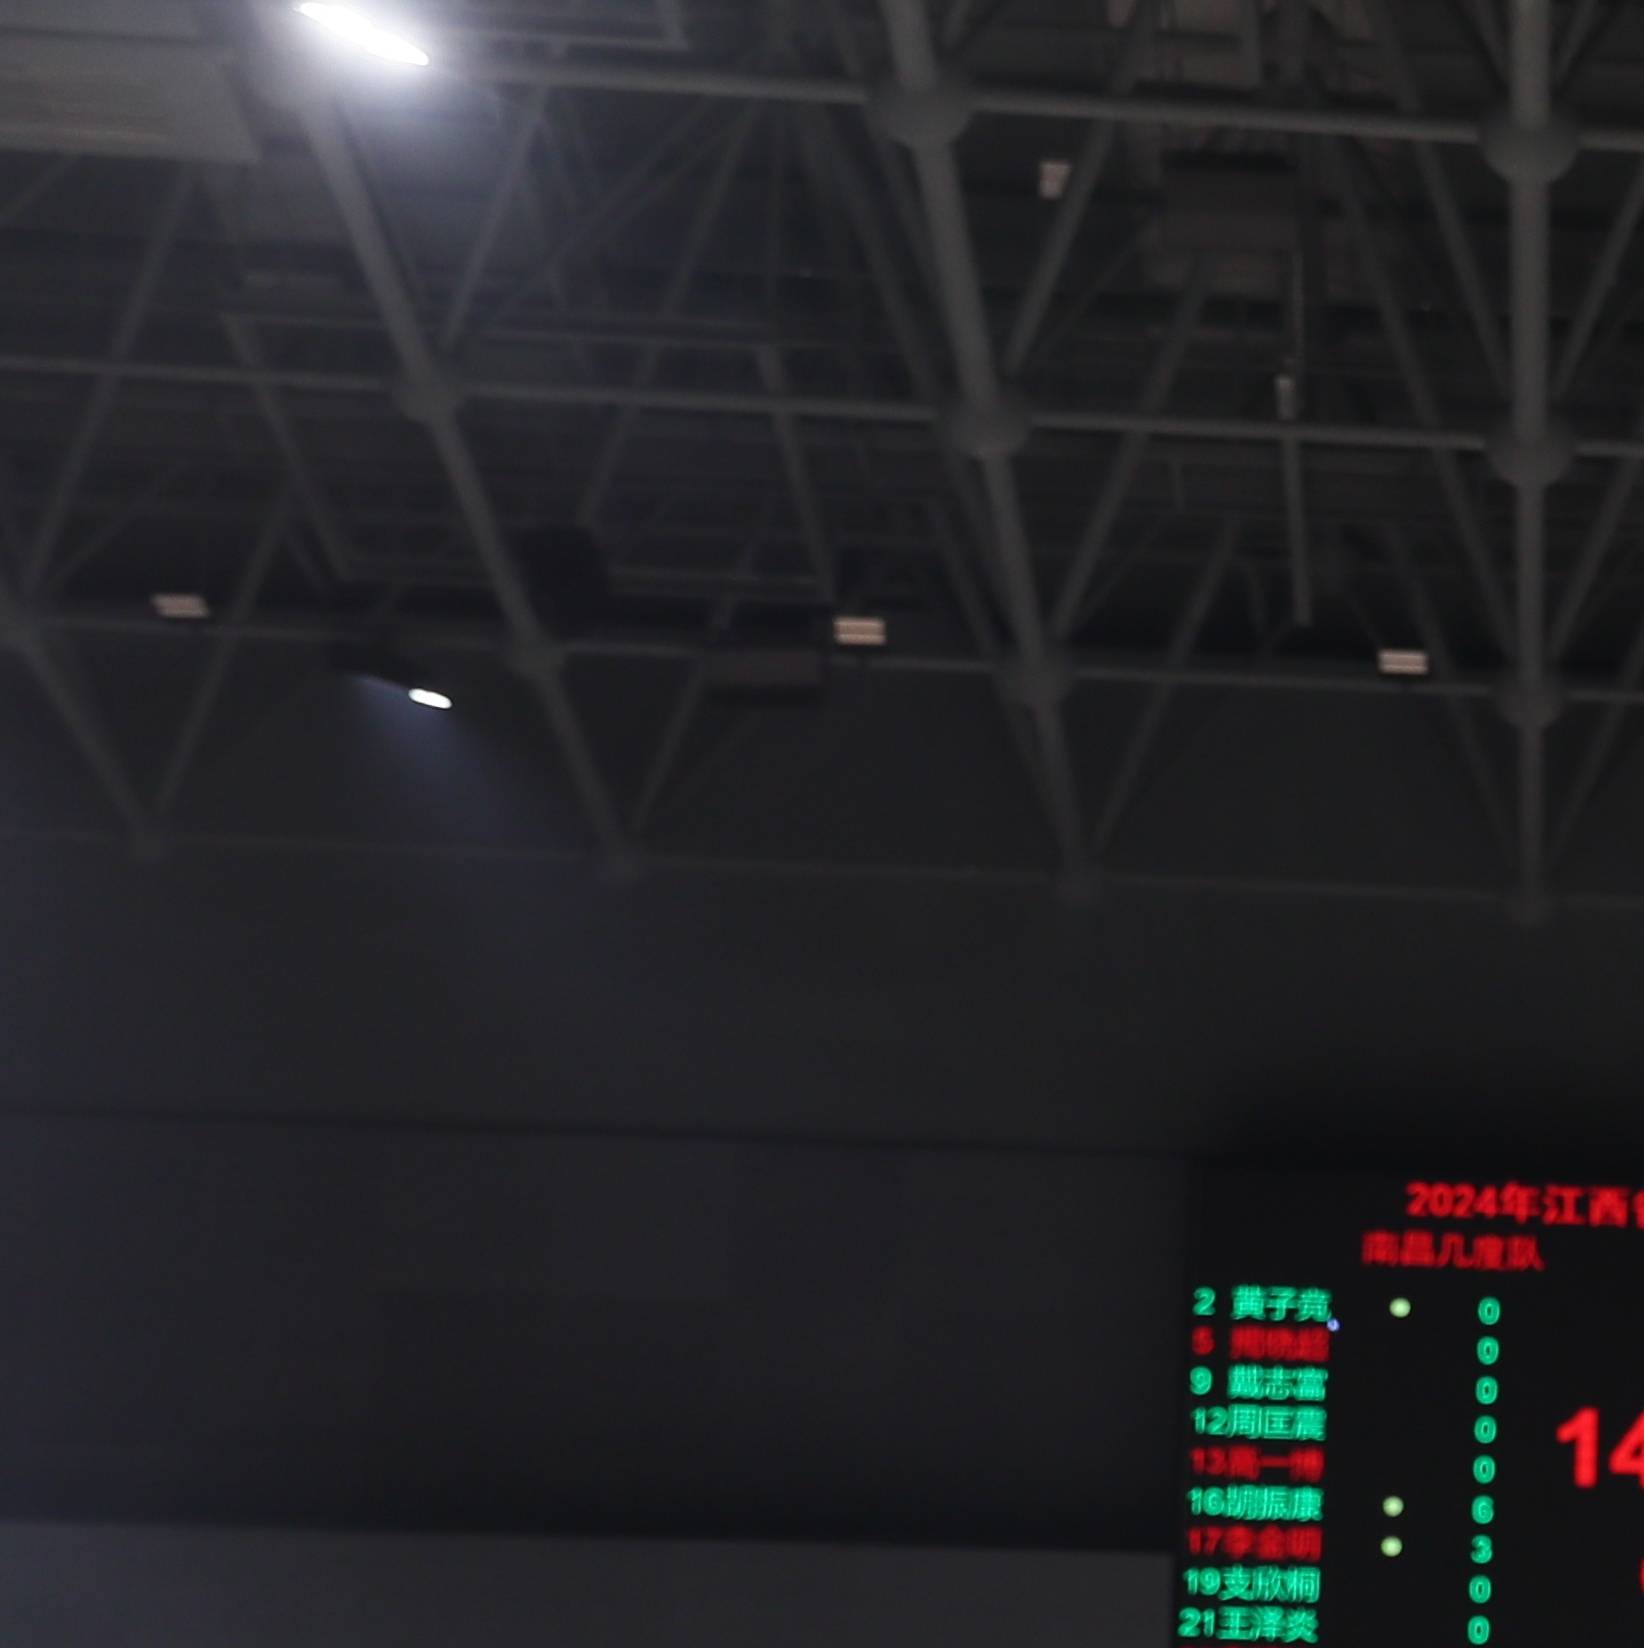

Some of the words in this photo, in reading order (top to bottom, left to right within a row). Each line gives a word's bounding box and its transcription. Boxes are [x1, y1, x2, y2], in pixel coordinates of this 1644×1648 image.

[1194, 1288, 1215, 1315] 2
[1478, 1297, 1500, 1325] 0
[1477, 1336, 1499, 1365] 0
[1190, 1367, 1212, 1395] 9
[1475, 1376, 1498, 1405] 0
[1474, 1415, 1497, 1444] 0
[1473, 1455, 1496, 1484] 0
[1471, 1495, 1494, 1524] 6
[1471, 1535, 1493, 1564] 3
[1469, 1575, 1492, 1603] 0
[1467, 1615, 1490, 1645] 0
